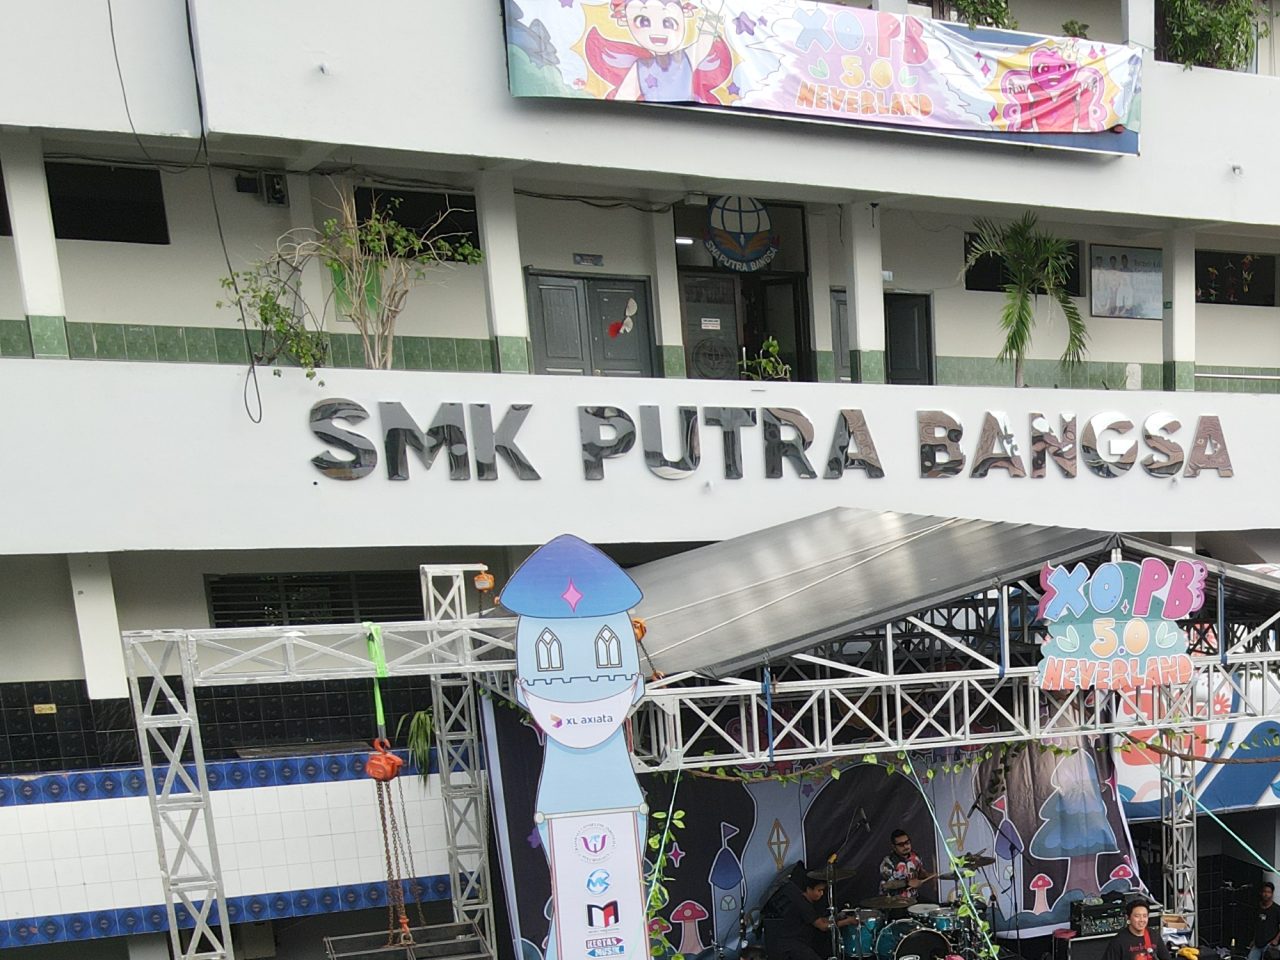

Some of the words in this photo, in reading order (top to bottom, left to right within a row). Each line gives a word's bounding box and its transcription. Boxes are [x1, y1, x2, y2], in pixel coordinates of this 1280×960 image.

[840, 55, 893, 89] 5.0
[797, 80, 933, 118] NEVERLAND
[719, 254, 748, 272] PUTRA
[750, 246, 778, 272] BANGSA
[309, 396, 542, 481] SMK
[576, 403, 887, 481] PUTRA
[916, 410, 1234, 479] BANGSA
[1090, 618, 1150, 658] 5.0
[1041, 653, 1195, 691] NEVERLAND
[581, 714, 613, 725] axiata
